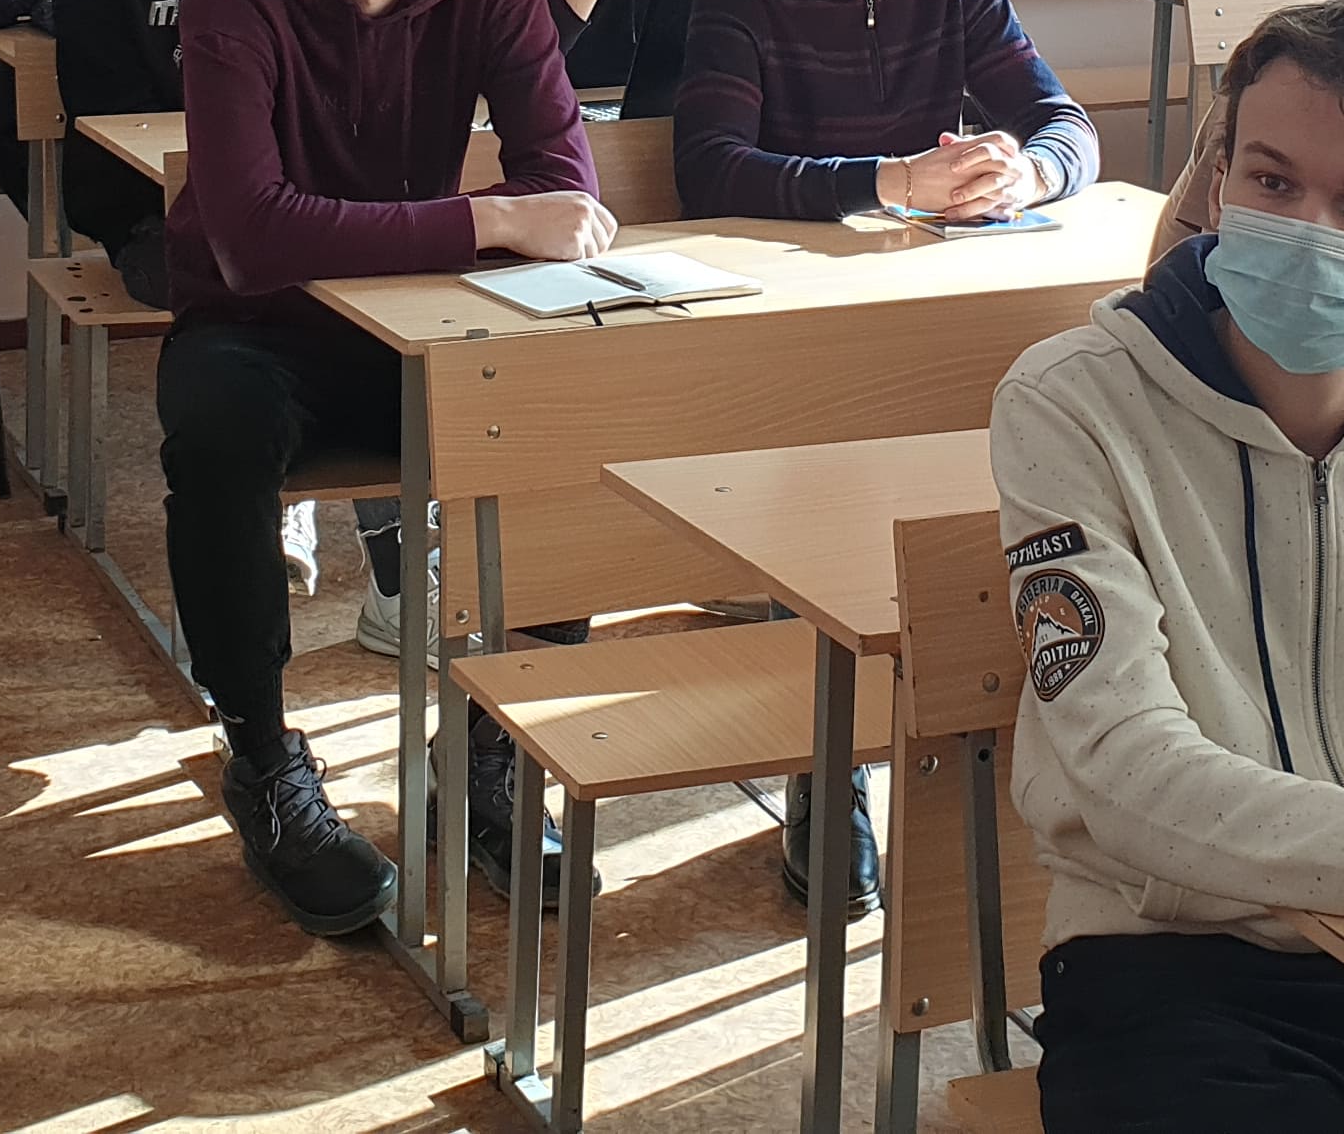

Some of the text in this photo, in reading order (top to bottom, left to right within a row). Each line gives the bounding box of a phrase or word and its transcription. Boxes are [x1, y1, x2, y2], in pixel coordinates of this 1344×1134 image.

[1009, 532, 1072, 566] RTHEAST
[1019, 577, 1095, 626] SIBERIA BAIKAL
